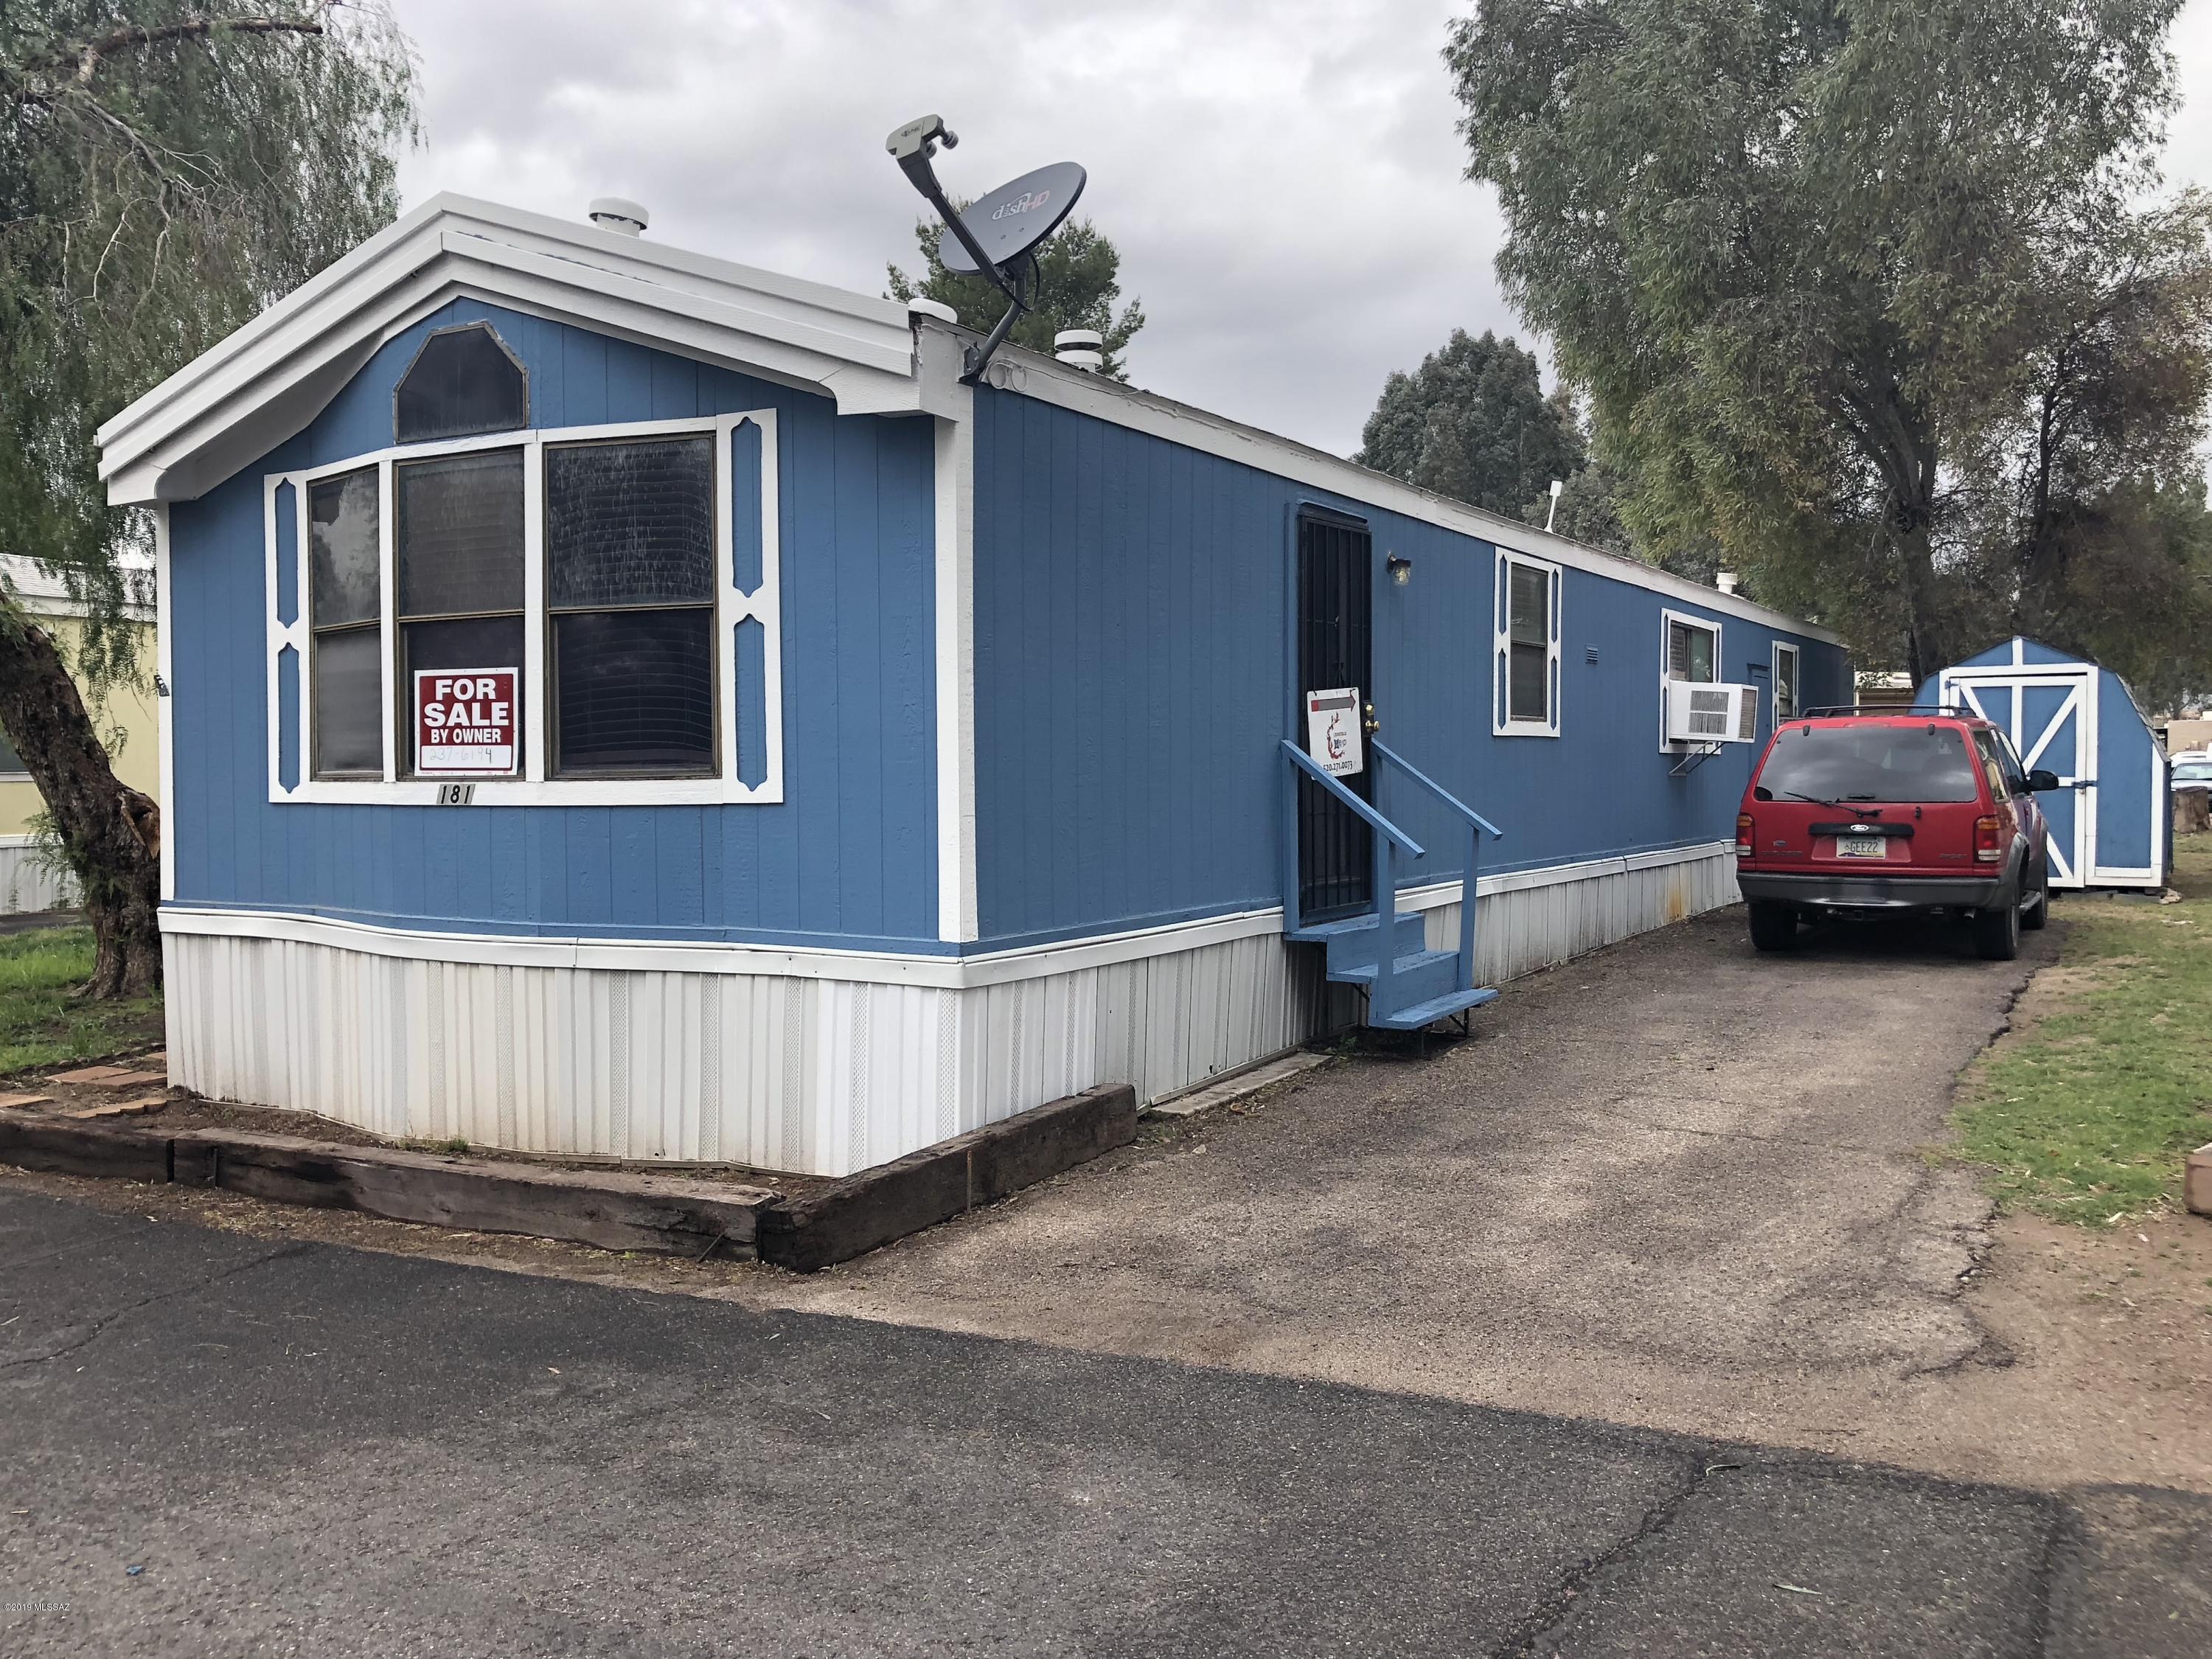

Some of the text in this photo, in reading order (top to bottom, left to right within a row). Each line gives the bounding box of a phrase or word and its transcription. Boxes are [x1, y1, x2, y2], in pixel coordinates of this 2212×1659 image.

[435, 678, 496, 700] FOR
[424, 702, 509, 727] SALE
[431, 728, 501, 743] BY OWNER
[441, 785, 471, 804] 181
[1850, 841, 1878, 853] GEE22
